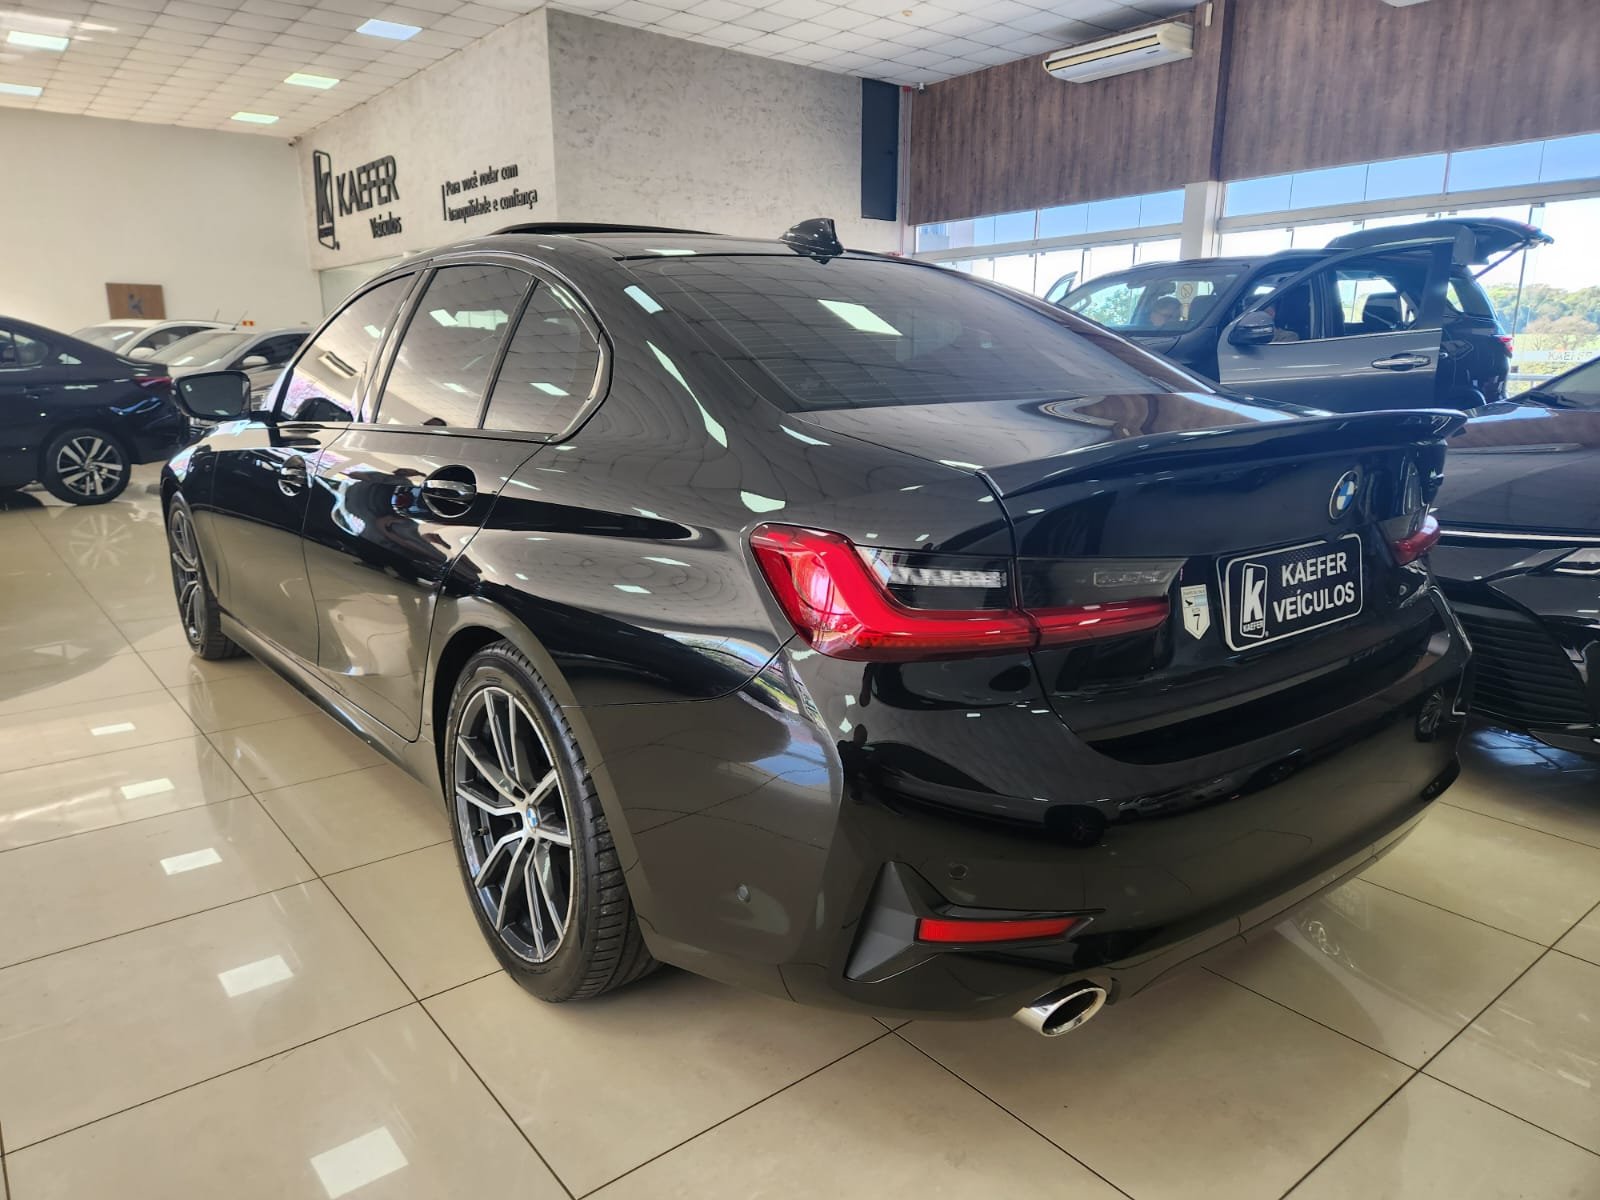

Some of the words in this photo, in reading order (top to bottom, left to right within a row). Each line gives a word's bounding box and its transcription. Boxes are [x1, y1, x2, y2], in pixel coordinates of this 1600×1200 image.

[336, 155, 400, 217] KAEFER
[445, 180, 461, 197] Para
[462, 169, 478, 192] você
[480, 165, 500, 187] rodar
[501, 163, 518, 180] com
[493, 199, 499, 212] e
[500, 187, 538, 210] confiança
[369, 211, 402, 239] Veículos
[1281, 551, 1348, 588] KAEFER
[1272, 581, 1356, 623] VEÍCULOS
[1193, 613, 1201, 631] 7
